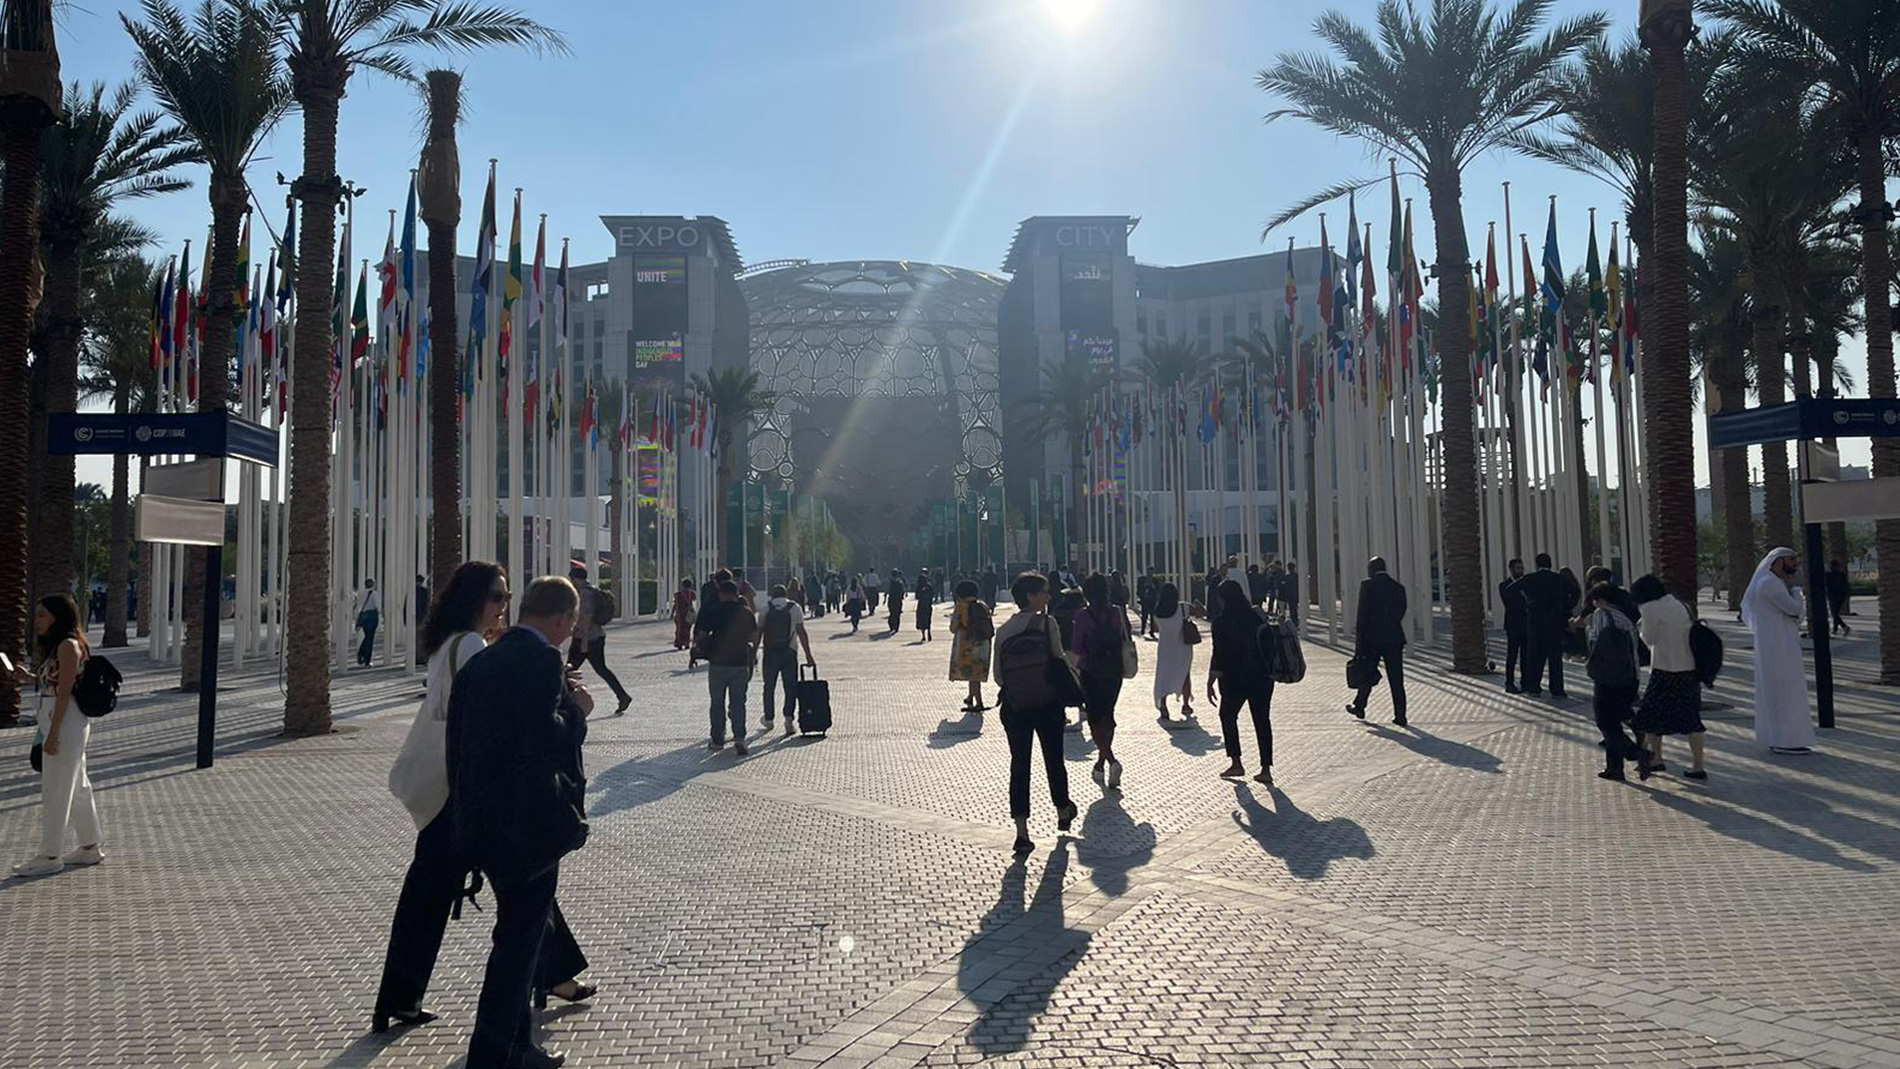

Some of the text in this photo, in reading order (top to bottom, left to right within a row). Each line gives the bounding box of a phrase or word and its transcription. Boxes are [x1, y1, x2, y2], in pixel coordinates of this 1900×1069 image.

[619, 226, 698, 247] EXPO
[1056, 226, 1116, 246] CITY
[637, 271, 667, 283] UNITE
[635, 340, 665, 348] WELCOME
[635, 361, 648, 369] DAY
